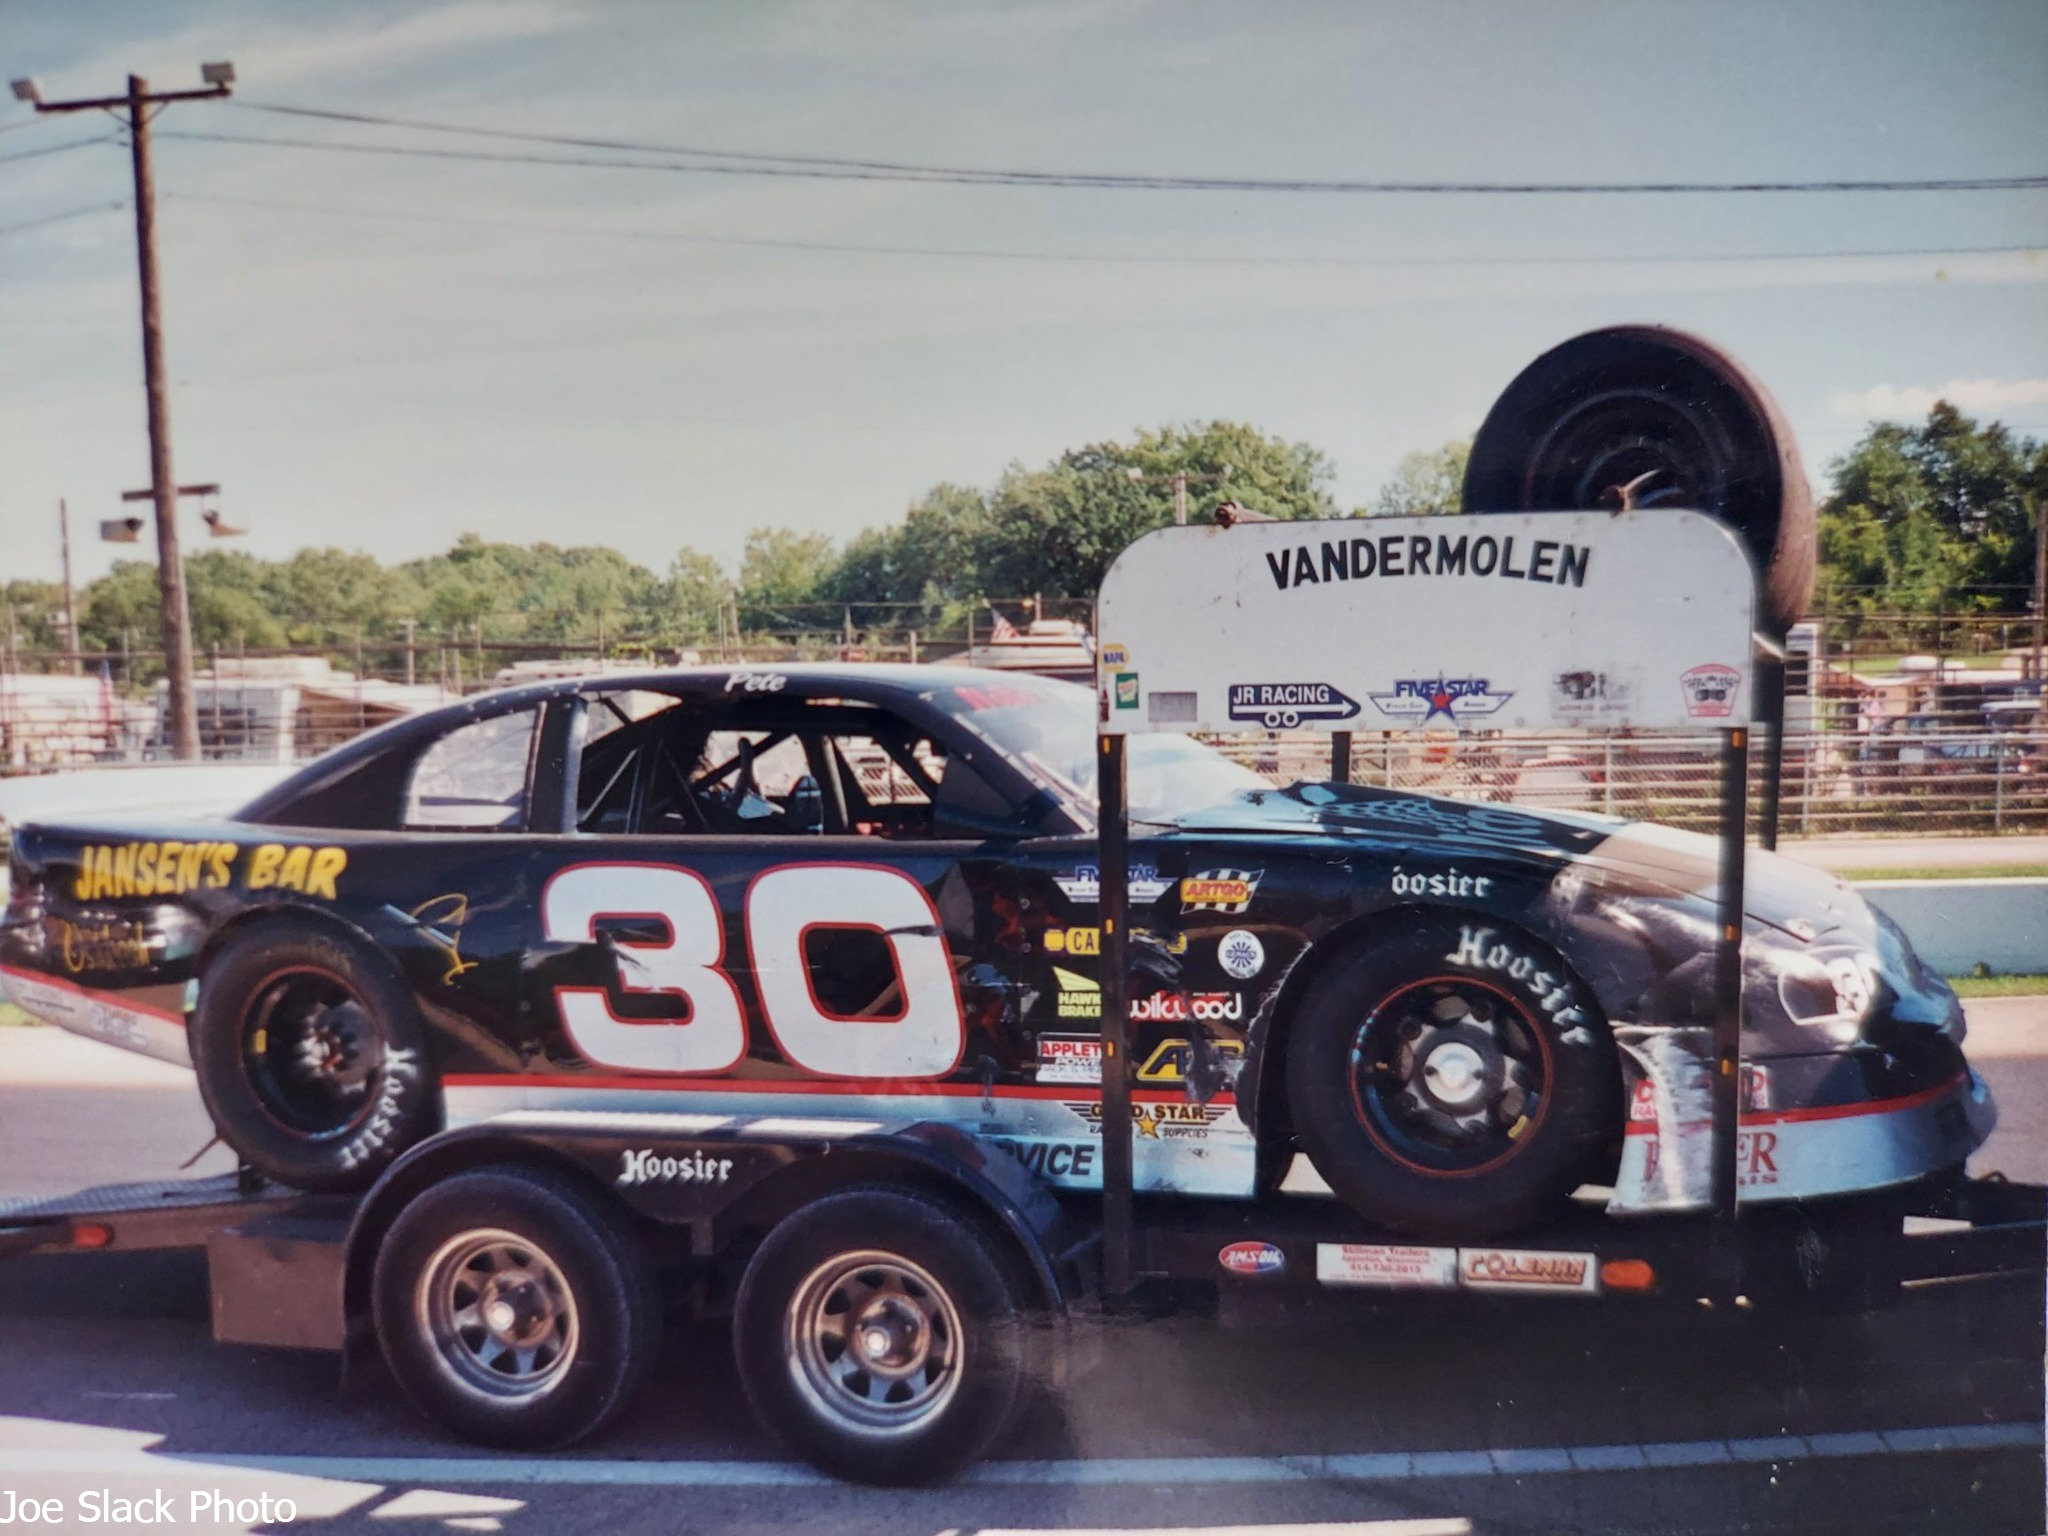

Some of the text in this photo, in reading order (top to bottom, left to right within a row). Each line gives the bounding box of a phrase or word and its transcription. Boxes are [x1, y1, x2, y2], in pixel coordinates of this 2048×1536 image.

[1265, 535, 1590, 591] VANDERMOLEN
[724, 671, 788, 693] Pete
[1233, 685, 1330, 704] JR RACING
[1395, 680, 1488, 697] FIVE STAR
[76, 842, 348, 900] JANSEN'S BAR
[1391, 865, 1493, 898] oosier
[1186, 882, 1246, 897] ARTGO
[541, 861, 966, 1079] 30
[1443, 925, 1592, 1046] Hoosier
[1042, 1042, 1101, 1057] APPLET
[1154, 1104, 1206, 1119] STAR
[617, 1148, 734, 1186] Hoosier
